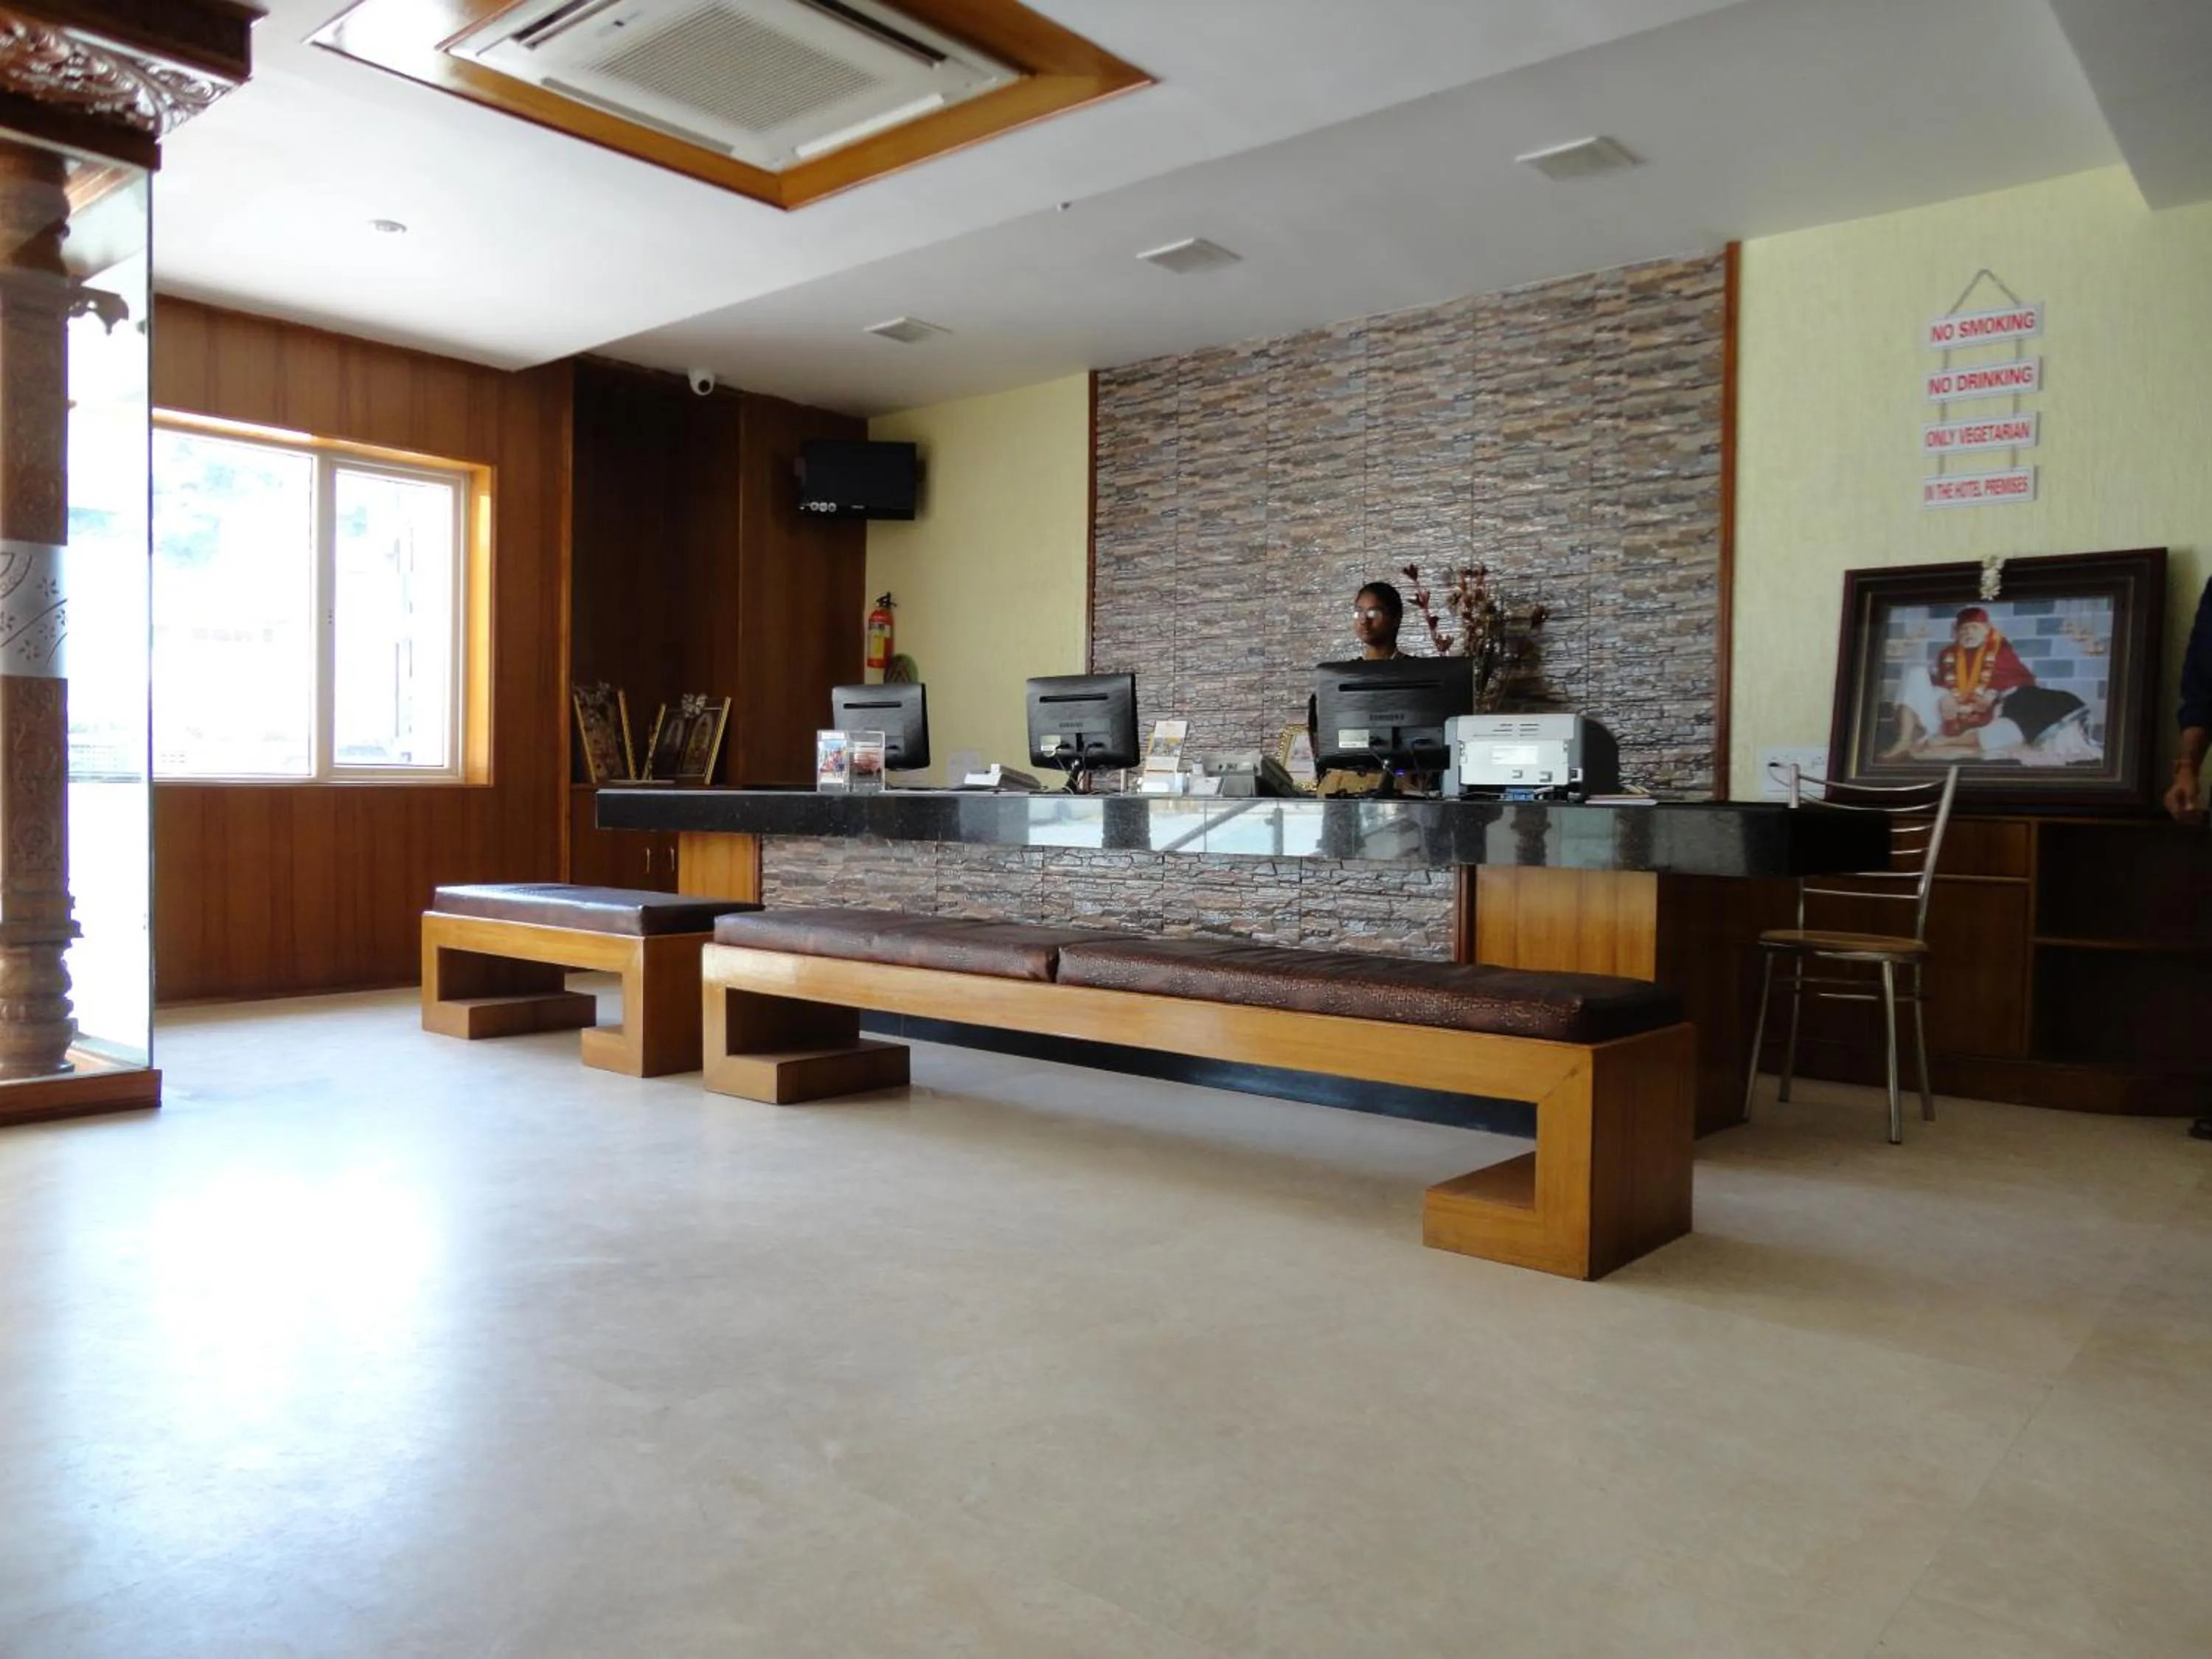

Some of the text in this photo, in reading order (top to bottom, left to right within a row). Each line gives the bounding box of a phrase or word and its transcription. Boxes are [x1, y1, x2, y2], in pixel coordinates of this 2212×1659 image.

[1932, 311, 2035, 341] NO SMOKING
[1929, 366, 2032, 394] NO DRINKING
[1926, 422, 2030, 447] ONLY VEGETARIAN
